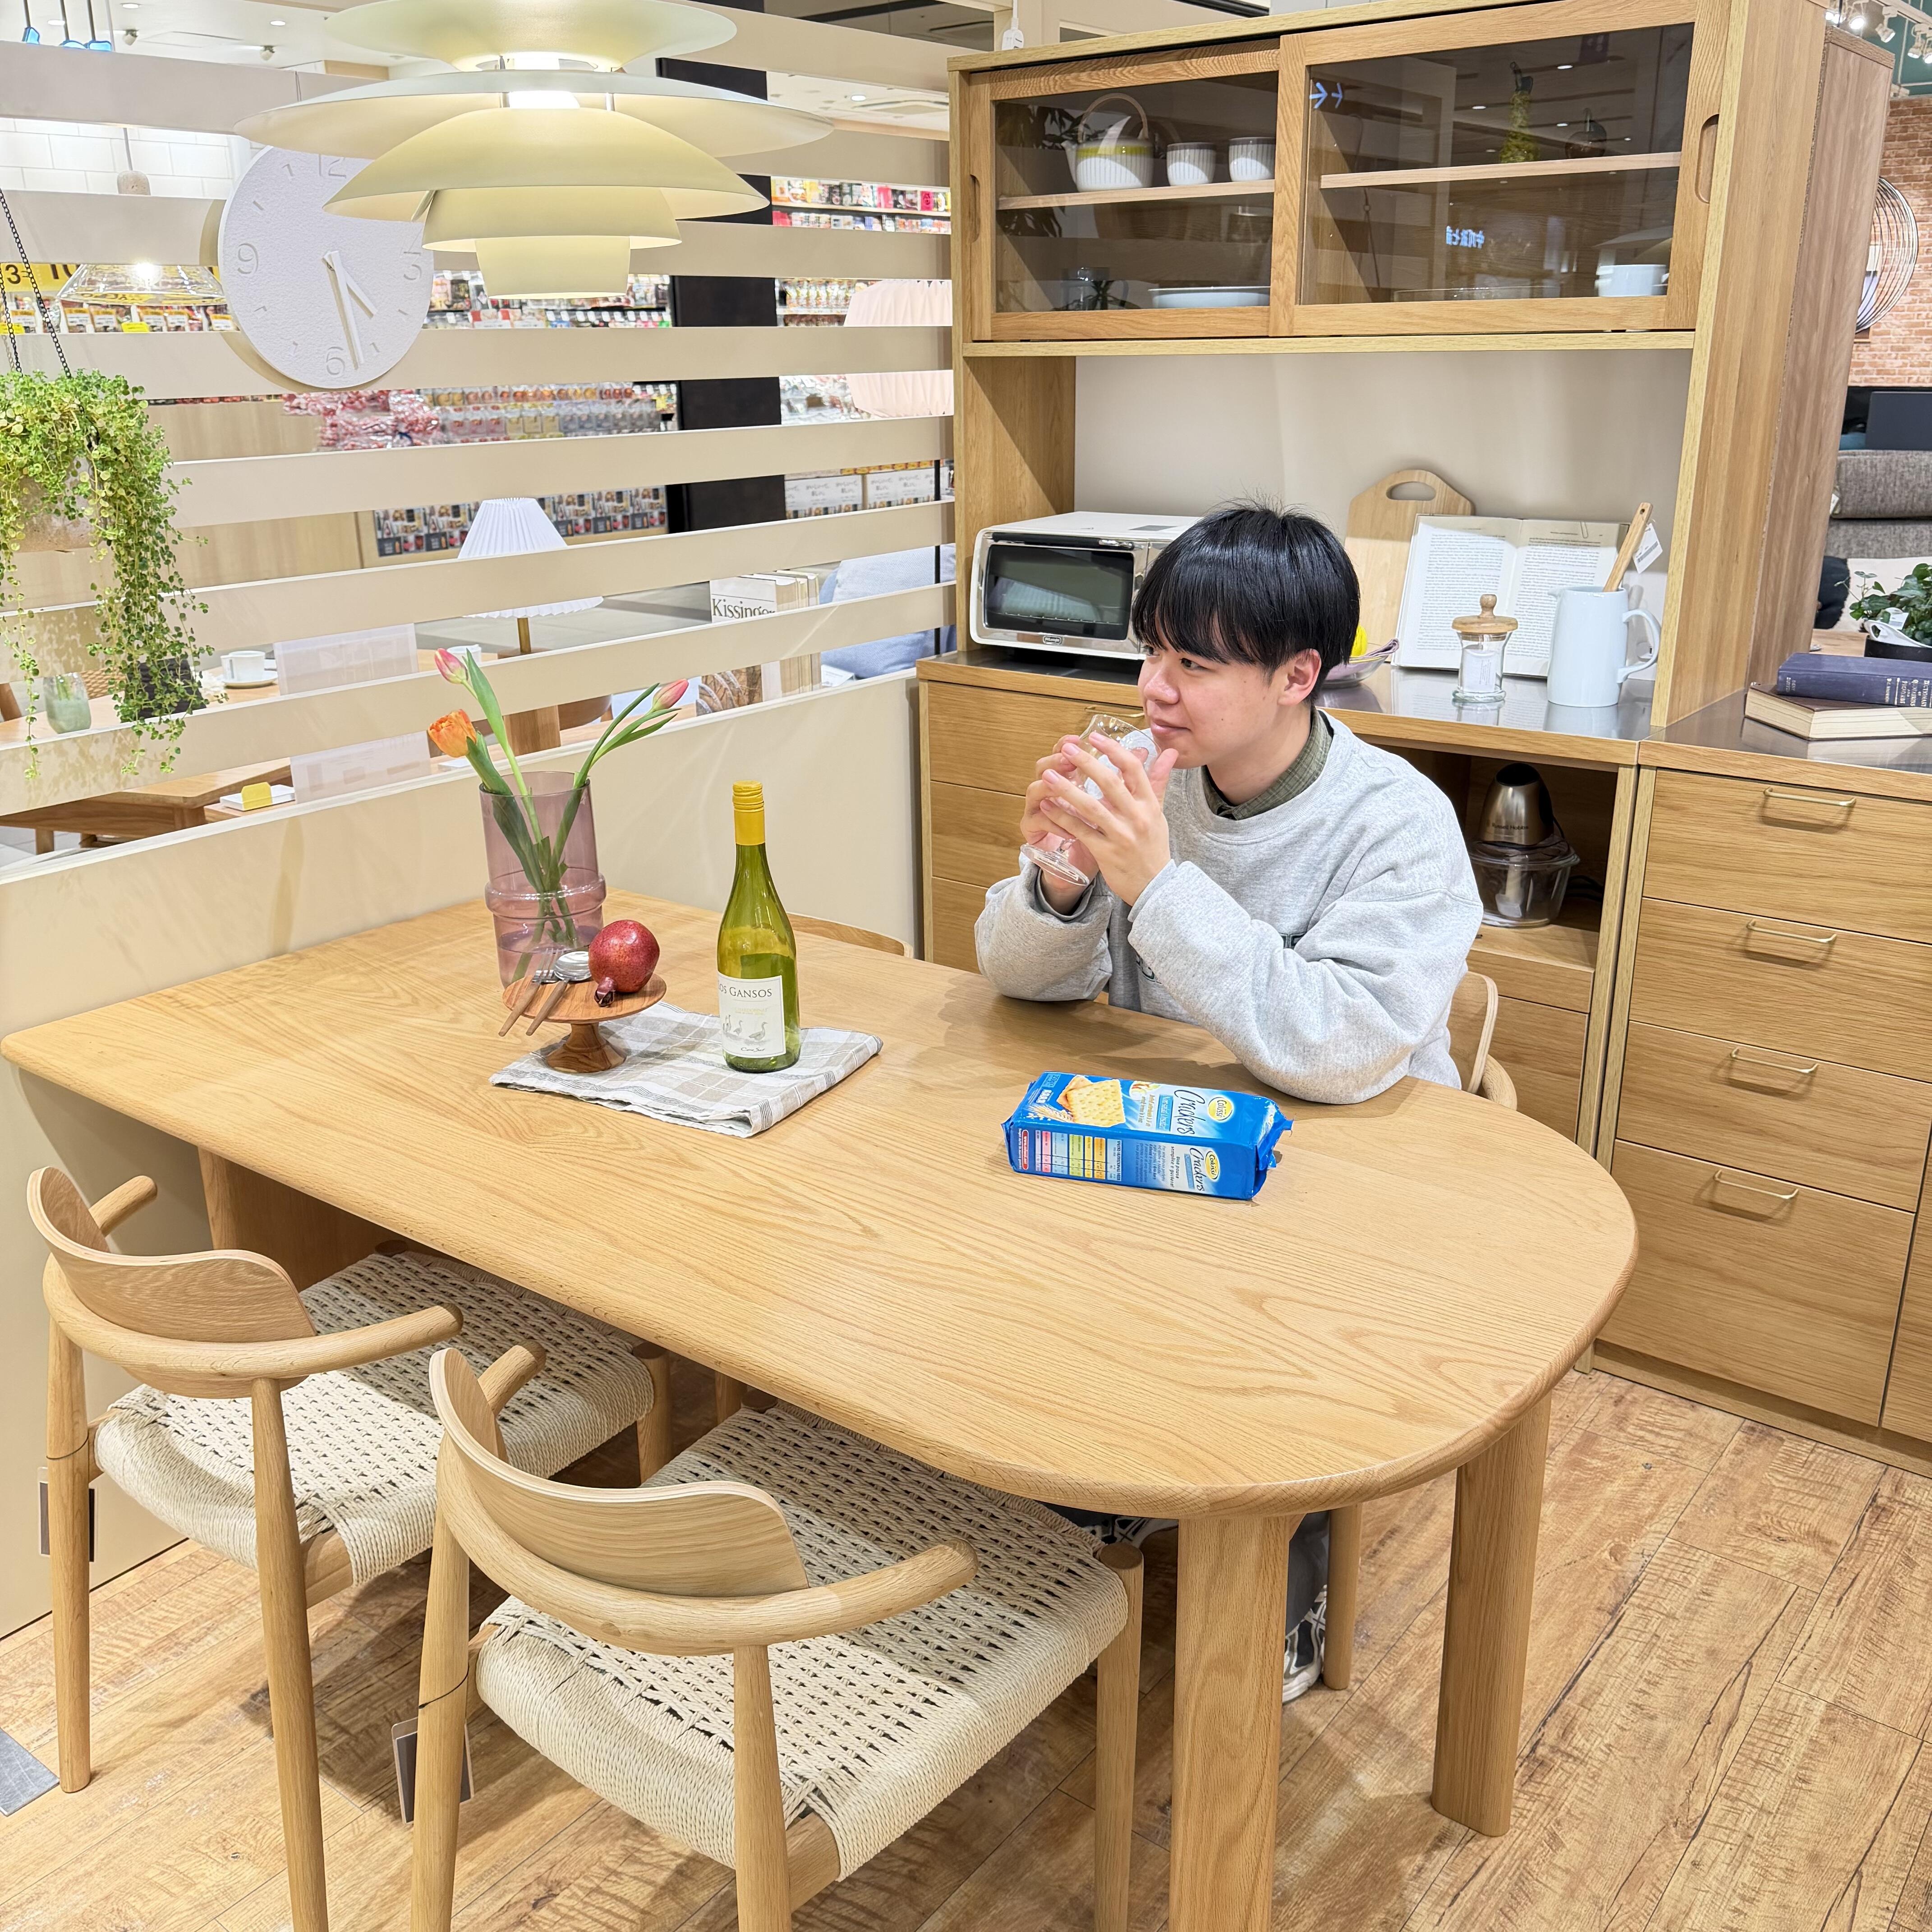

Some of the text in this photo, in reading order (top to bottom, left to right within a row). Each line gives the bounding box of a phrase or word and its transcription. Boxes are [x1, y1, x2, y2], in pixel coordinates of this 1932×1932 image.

[237, 243, 259, 275] 9
[326, 346, 345, 376] 6
[712, 598, 776, 620] Kissing
[729, 986, 773, 998] GANSOS
[1173, 1090, 1206, 1135] Crackers
[1216, 1099, 1227, 1118] Colussi
[1189, 1147, 1207, 1191] Crackers
